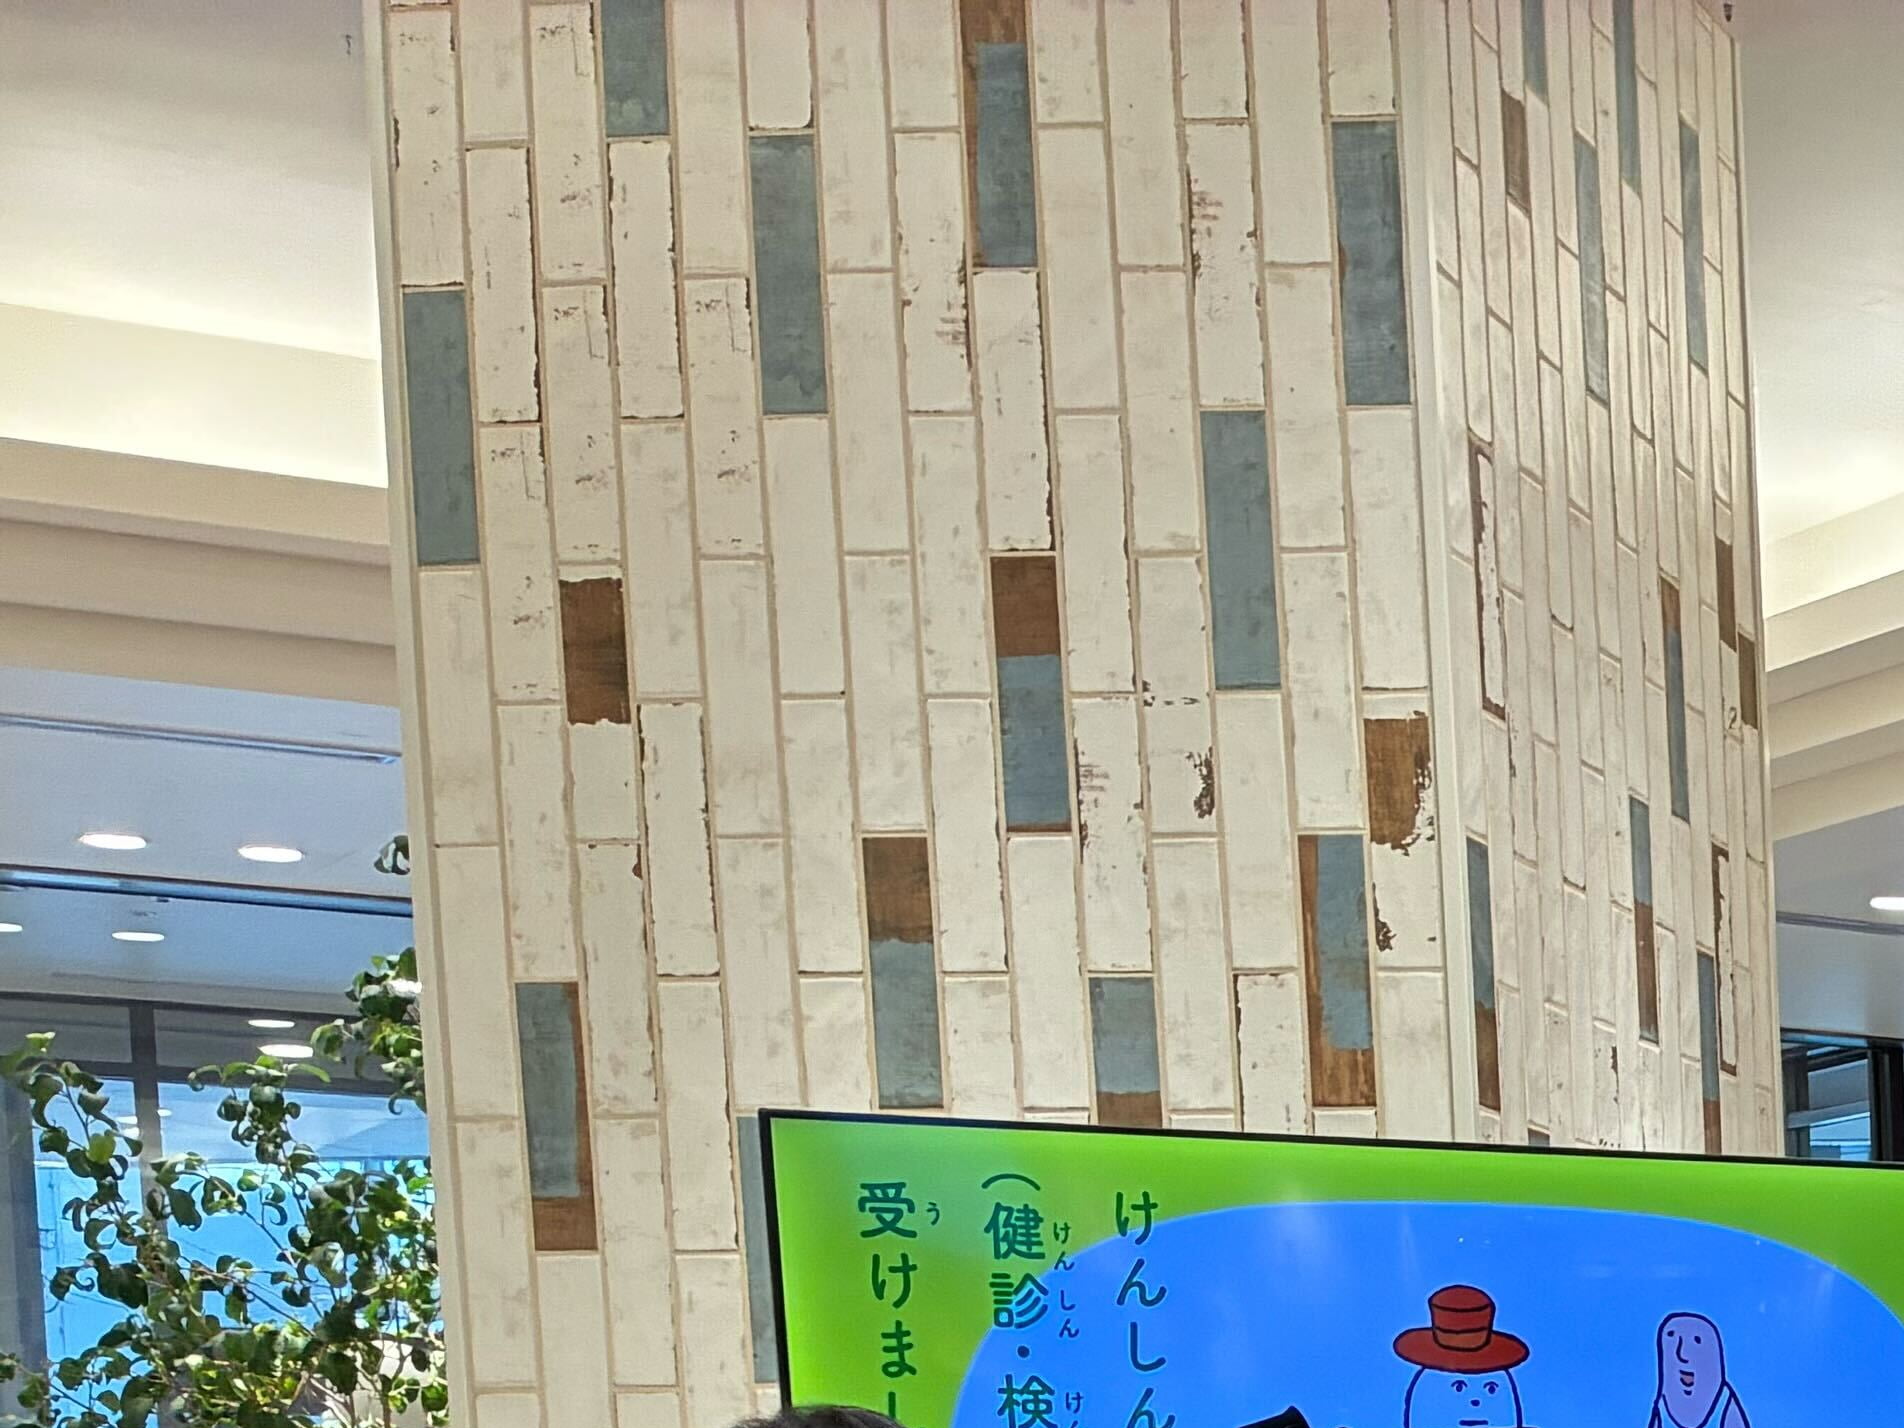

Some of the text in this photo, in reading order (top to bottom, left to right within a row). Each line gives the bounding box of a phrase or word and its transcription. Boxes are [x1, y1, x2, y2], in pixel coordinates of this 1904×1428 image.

[923, 1201, 942, 1227] う
[1053, 1220, 1077, 1273] けん
[1058, 1290, 1081, 1341] しん
